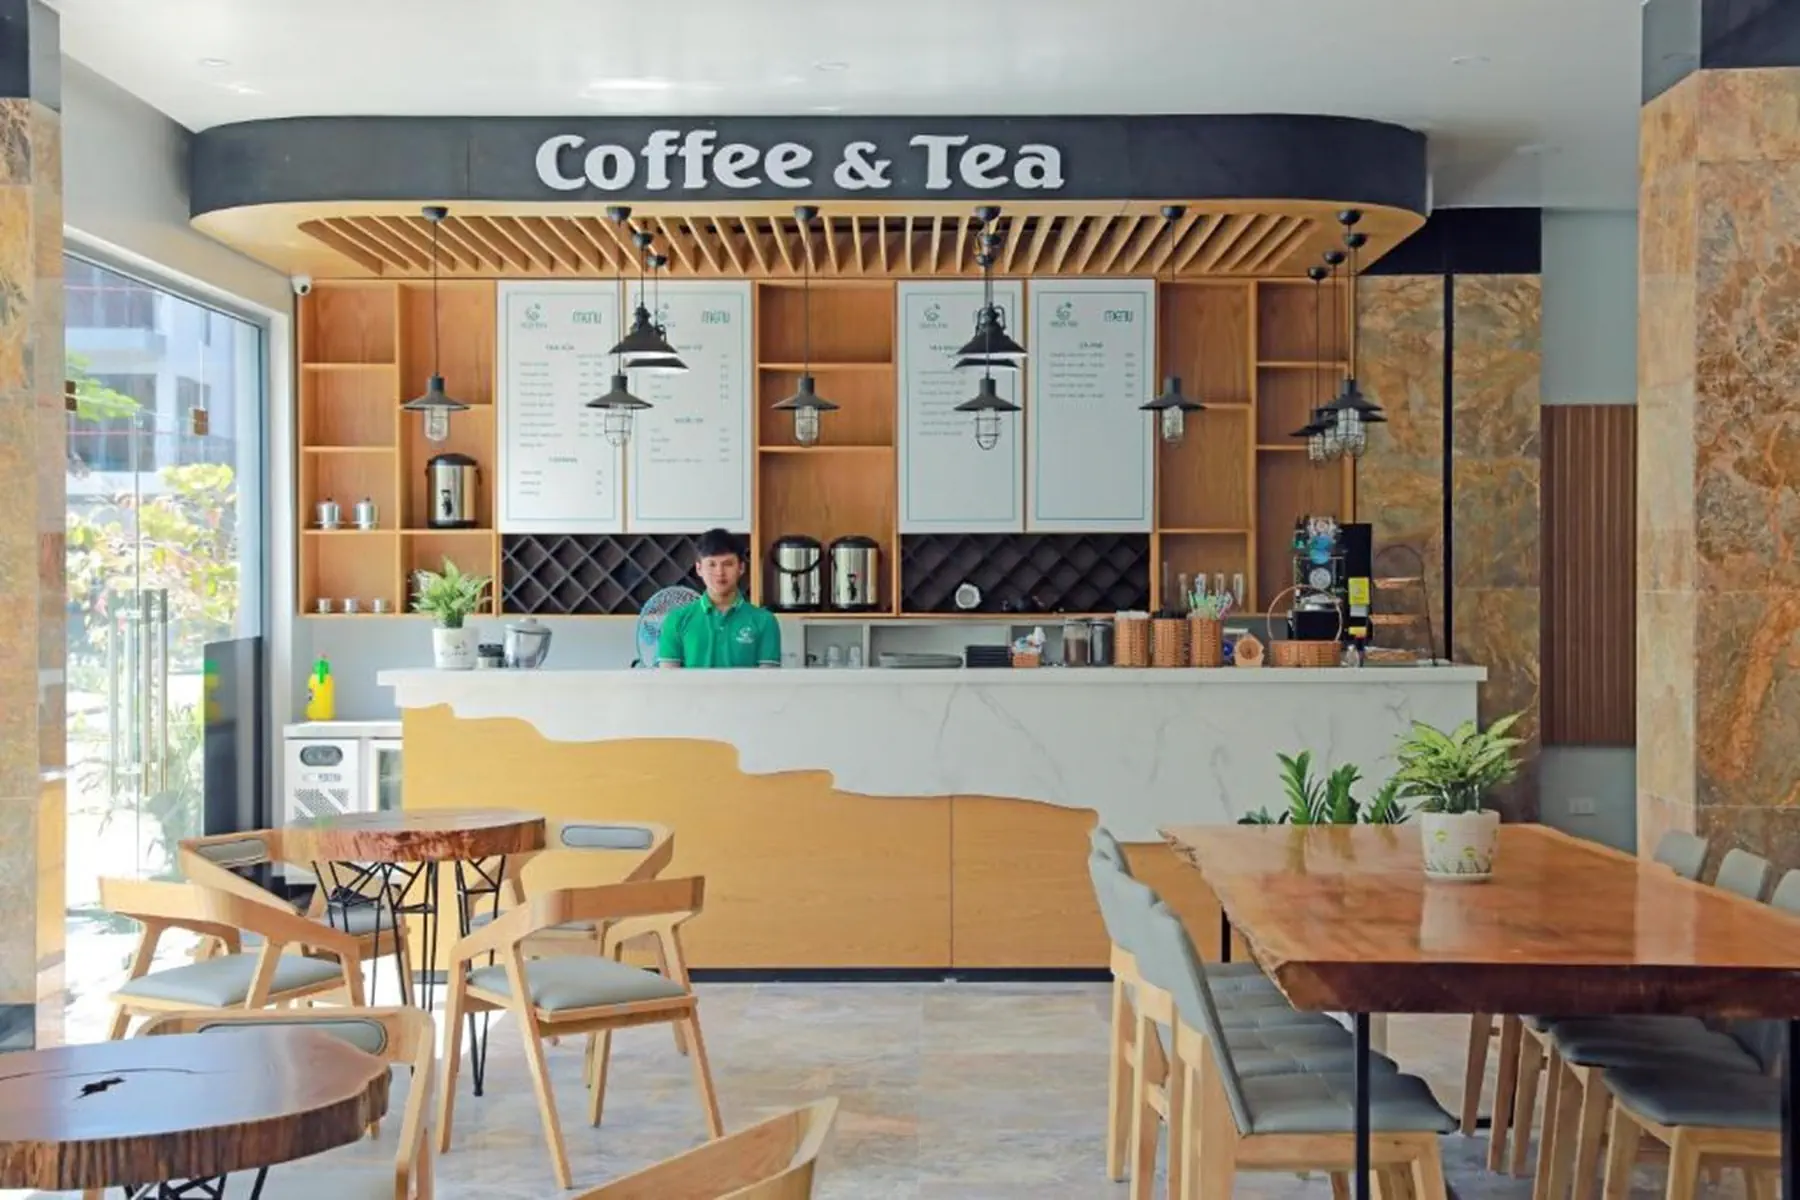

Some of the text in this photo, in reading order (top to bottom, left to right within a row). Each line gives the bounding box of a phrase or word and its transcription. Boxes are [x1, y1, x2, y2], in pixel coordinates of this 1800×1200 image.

[535, 129, 1066, 191] Coffee & Tea
